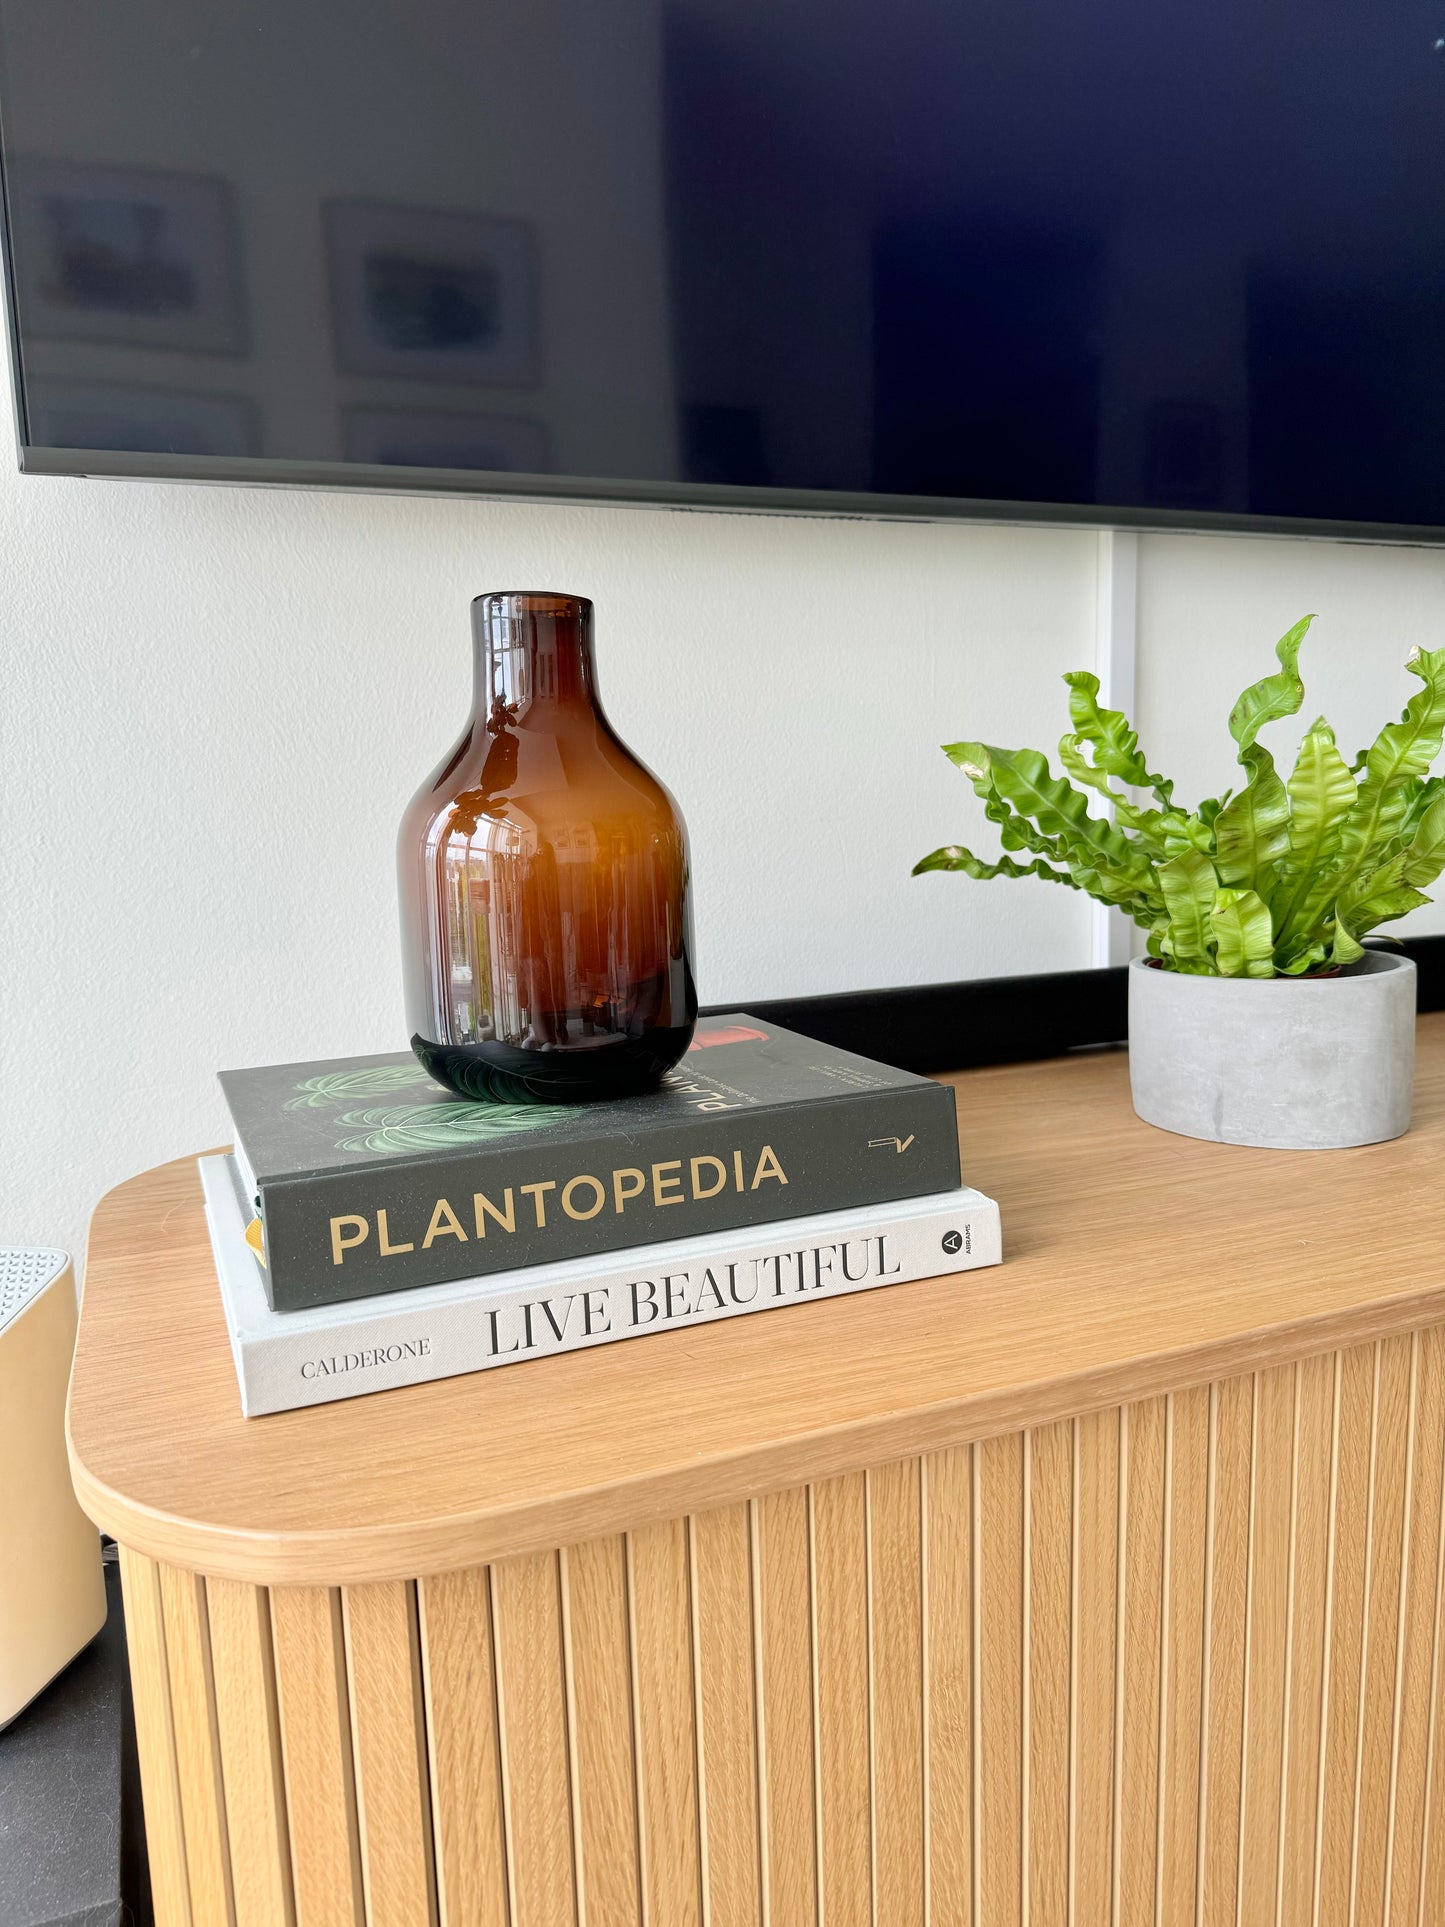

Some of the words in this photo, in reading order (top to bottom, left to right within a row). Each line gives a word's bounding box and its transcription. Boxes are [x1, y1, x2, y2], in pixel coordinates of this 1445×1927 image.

[658, 1070, 743, 1112] PLAN
[329, 1145, 789, 1265] PLANTOPEDIA
[485, 1288, 612, 1357] LIVE
[626, 1235, 902, 1327] BEAUTIFUL
[301, 1338, 432, 1379] CALDERONE
